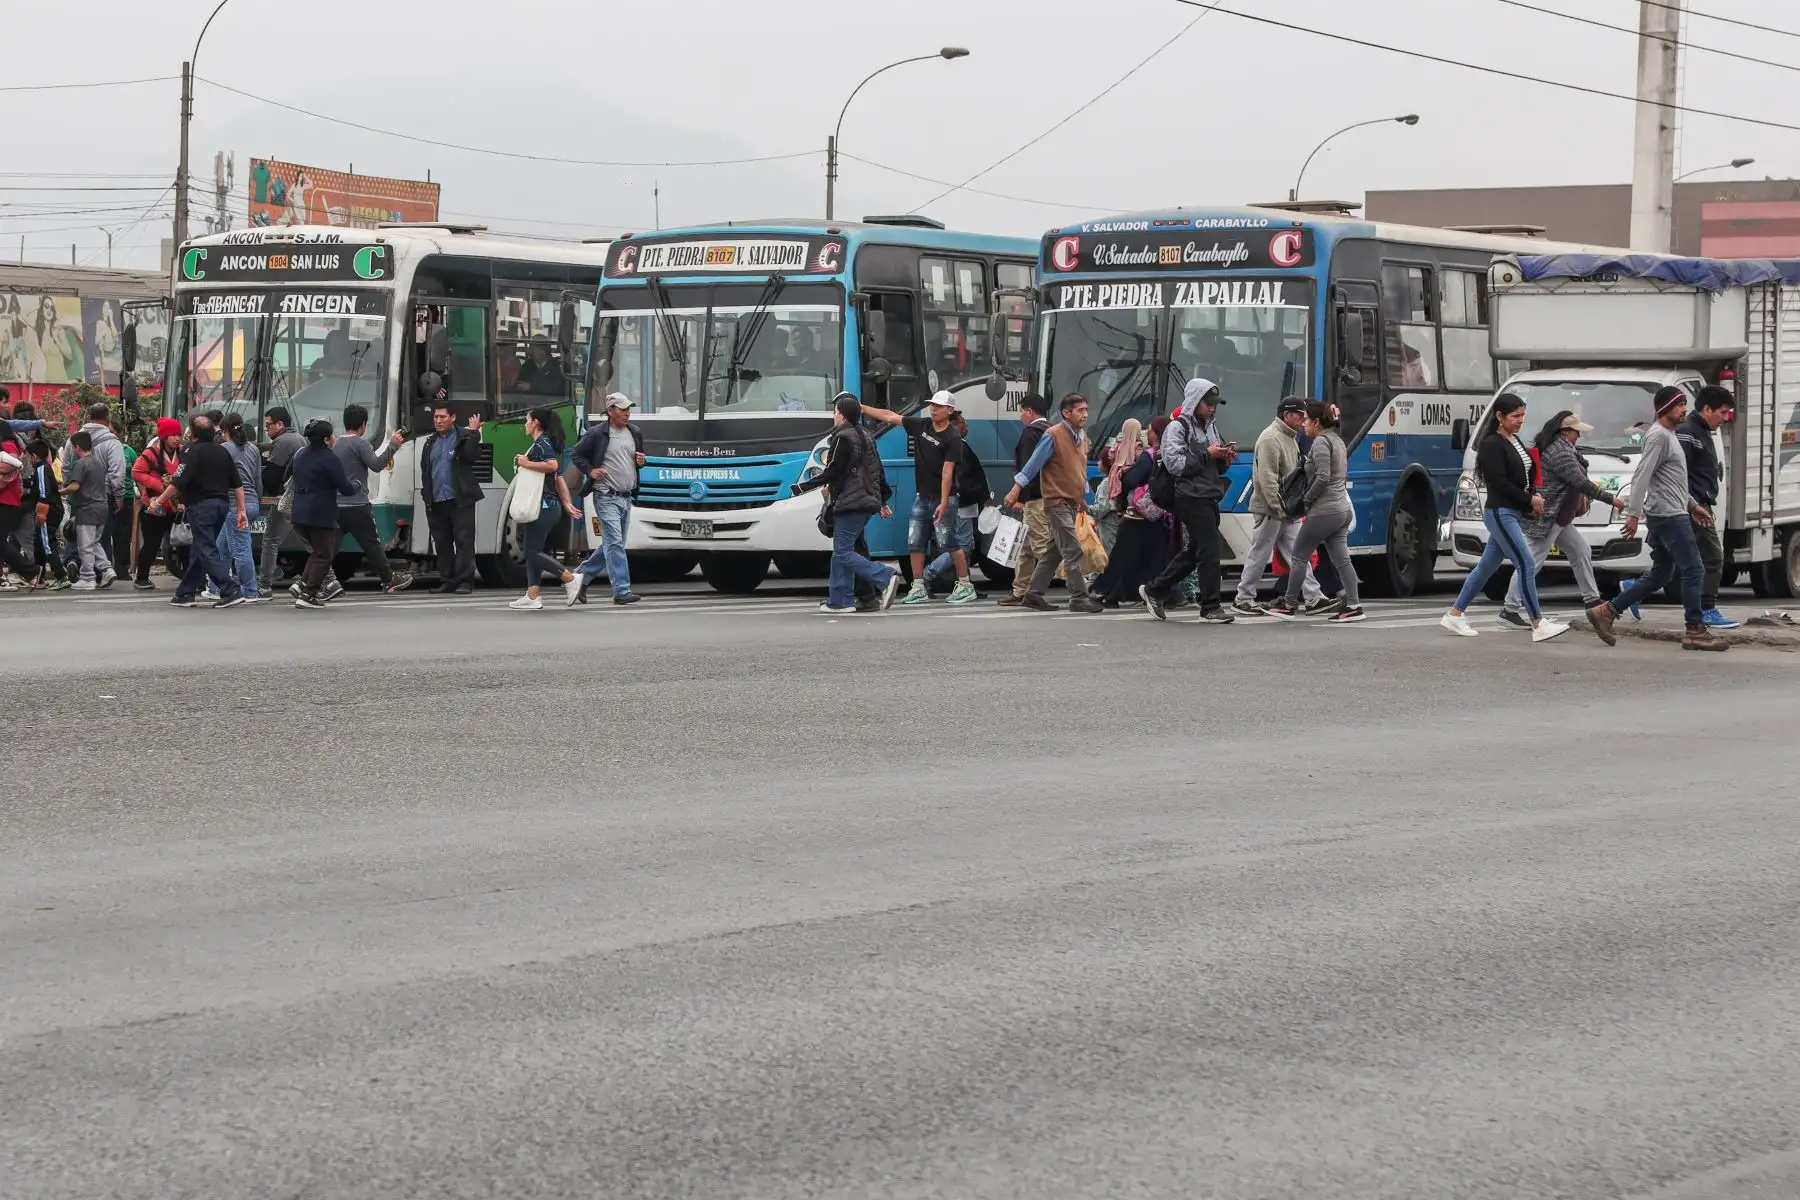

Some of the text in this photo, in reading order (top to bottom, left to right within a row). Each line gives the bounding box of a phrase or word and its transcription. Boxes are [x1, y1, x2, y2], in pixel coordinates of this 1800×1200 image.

[1082, 221, 1148, 233] V. SALVADOR
[1195, 218, 1268, 229] CARABAYLLO
[222, 232, 344, 245] ANCON S.J.M.
[1269, 231, 1302, 267] C
[183, 247, 208, 281] C
[220, 254, 340, 270] ANCON 1804 SAN LUIS
[353, 246, 384, 280] C
[617, 245, 637, 273] C
[642, 245, 803, 268] PTE. PIEDRA 8107 V. SALVADOR
[818, 242, 841, 272] C
[1052, 236, 1080, 272] C
[1160, 247, 1181, 263] 8107
[1183, 241, 1249, 268] Carabayllo
[206, 295, 266, 313] ABANCAY
[279, 294, 358, 313] ANCON
[1173, 281, 1285, 305] ZAPALLAL
[1421, 403, 1451, 426] LOMAS
[667, 446, 736, 457] Mercedes-Benz
[671, 469, 682, 480] SAN
[684, 469, 702, 480] FELIPE
[703, 469, 728, 480] EXPRESS
